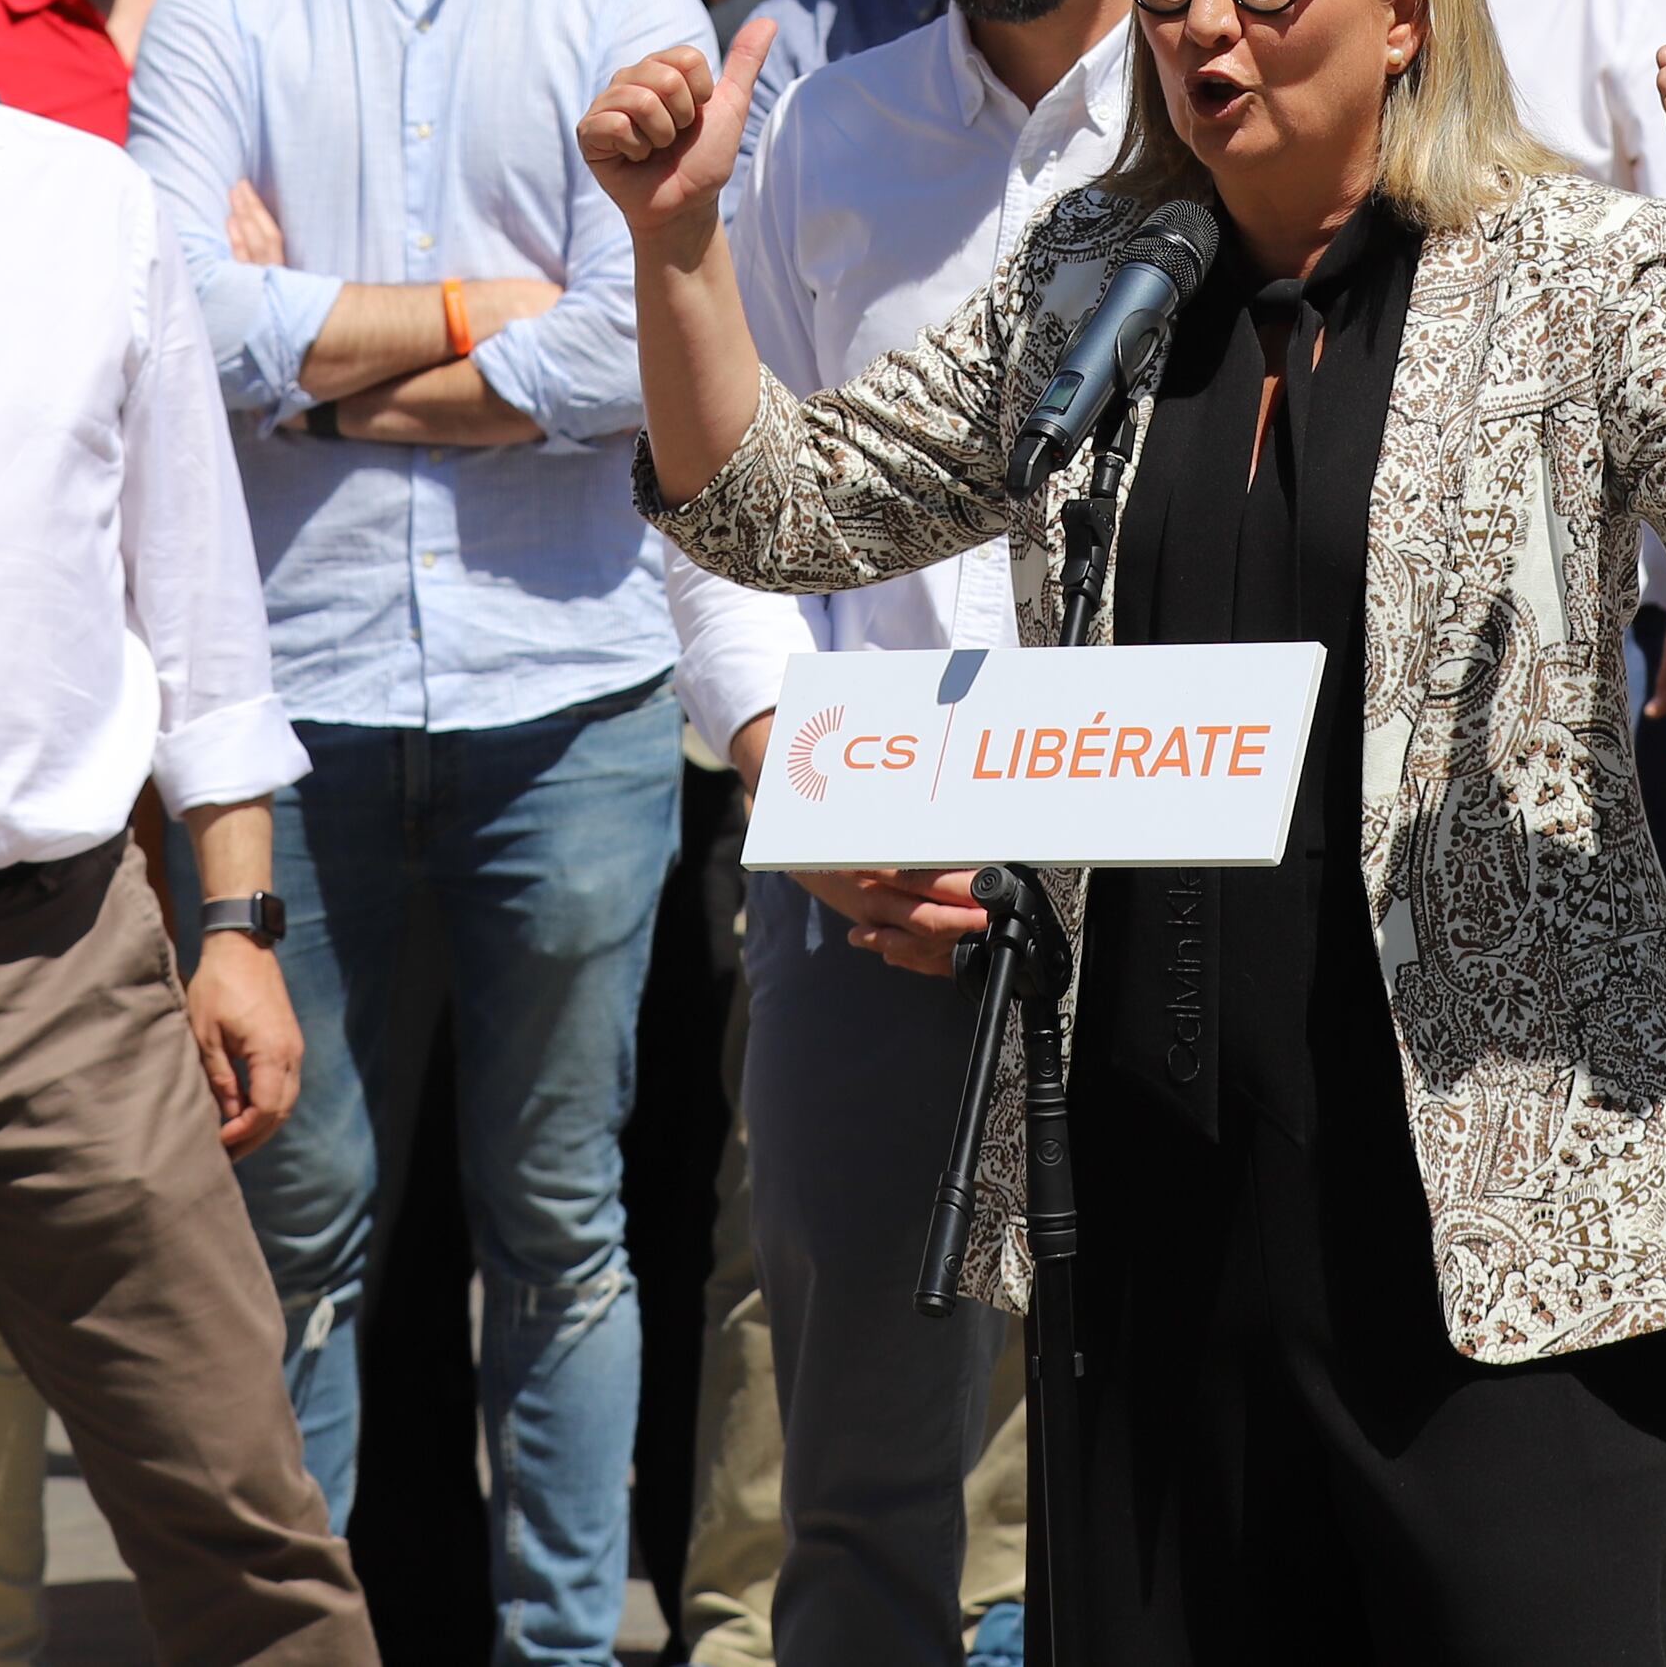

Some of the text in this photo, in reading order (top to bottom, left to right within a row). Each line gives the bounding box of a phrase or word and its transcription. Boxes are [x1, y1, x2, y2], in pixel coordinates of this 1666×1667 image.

[843, 711, 1271, 779] CS LIBÉRATE
[1166, 867, 1202, 1083] Calvin Kle
